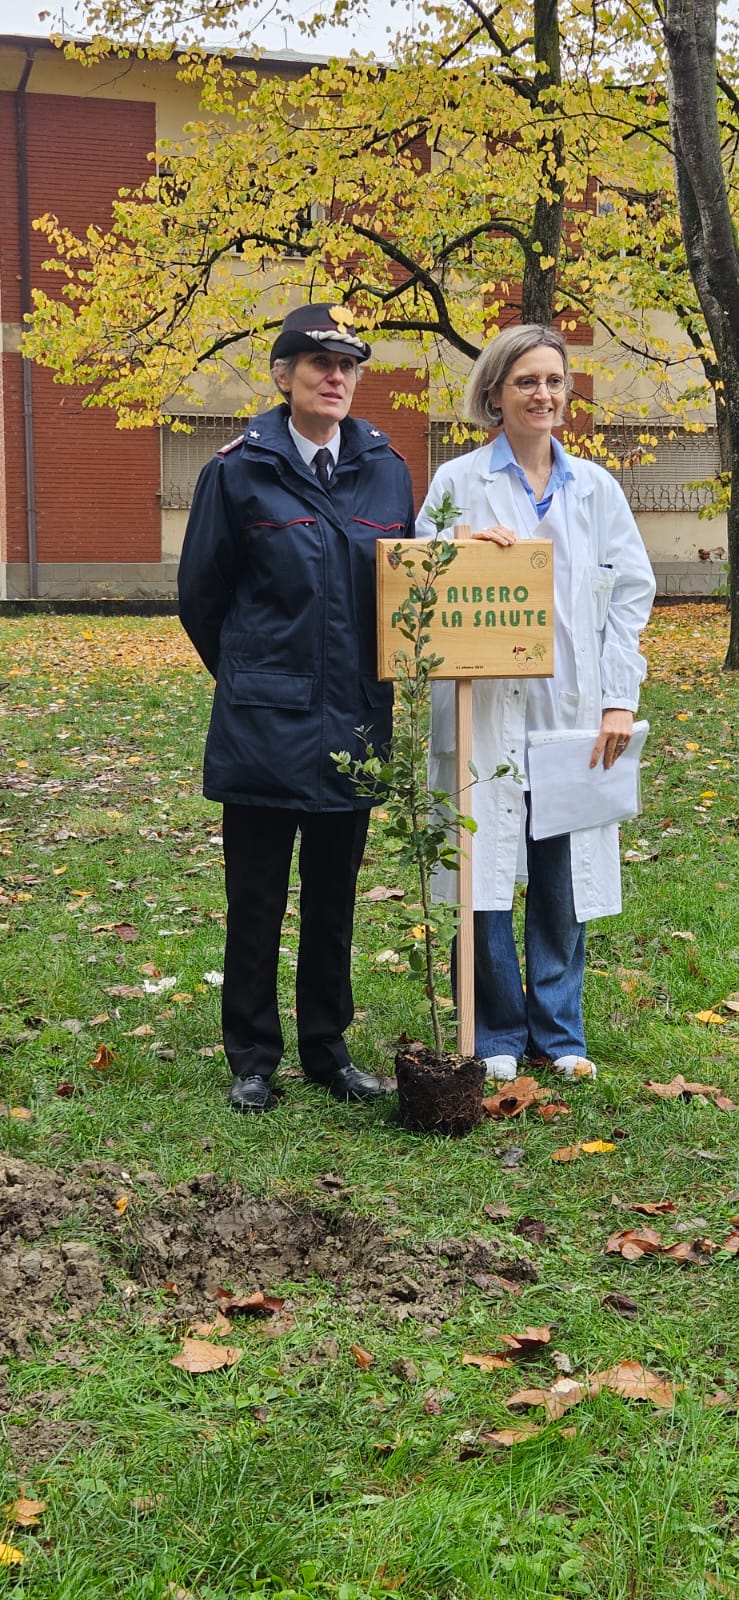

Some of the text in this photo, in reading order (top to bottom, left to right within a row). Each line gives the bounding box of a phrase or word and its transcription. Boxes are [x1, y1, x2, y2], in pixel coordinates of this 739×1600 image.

[447, 585, 529, 603] ALBERO
[441, 611, 463, 628] LA
[473, 609, 546, 628] SALUTE
